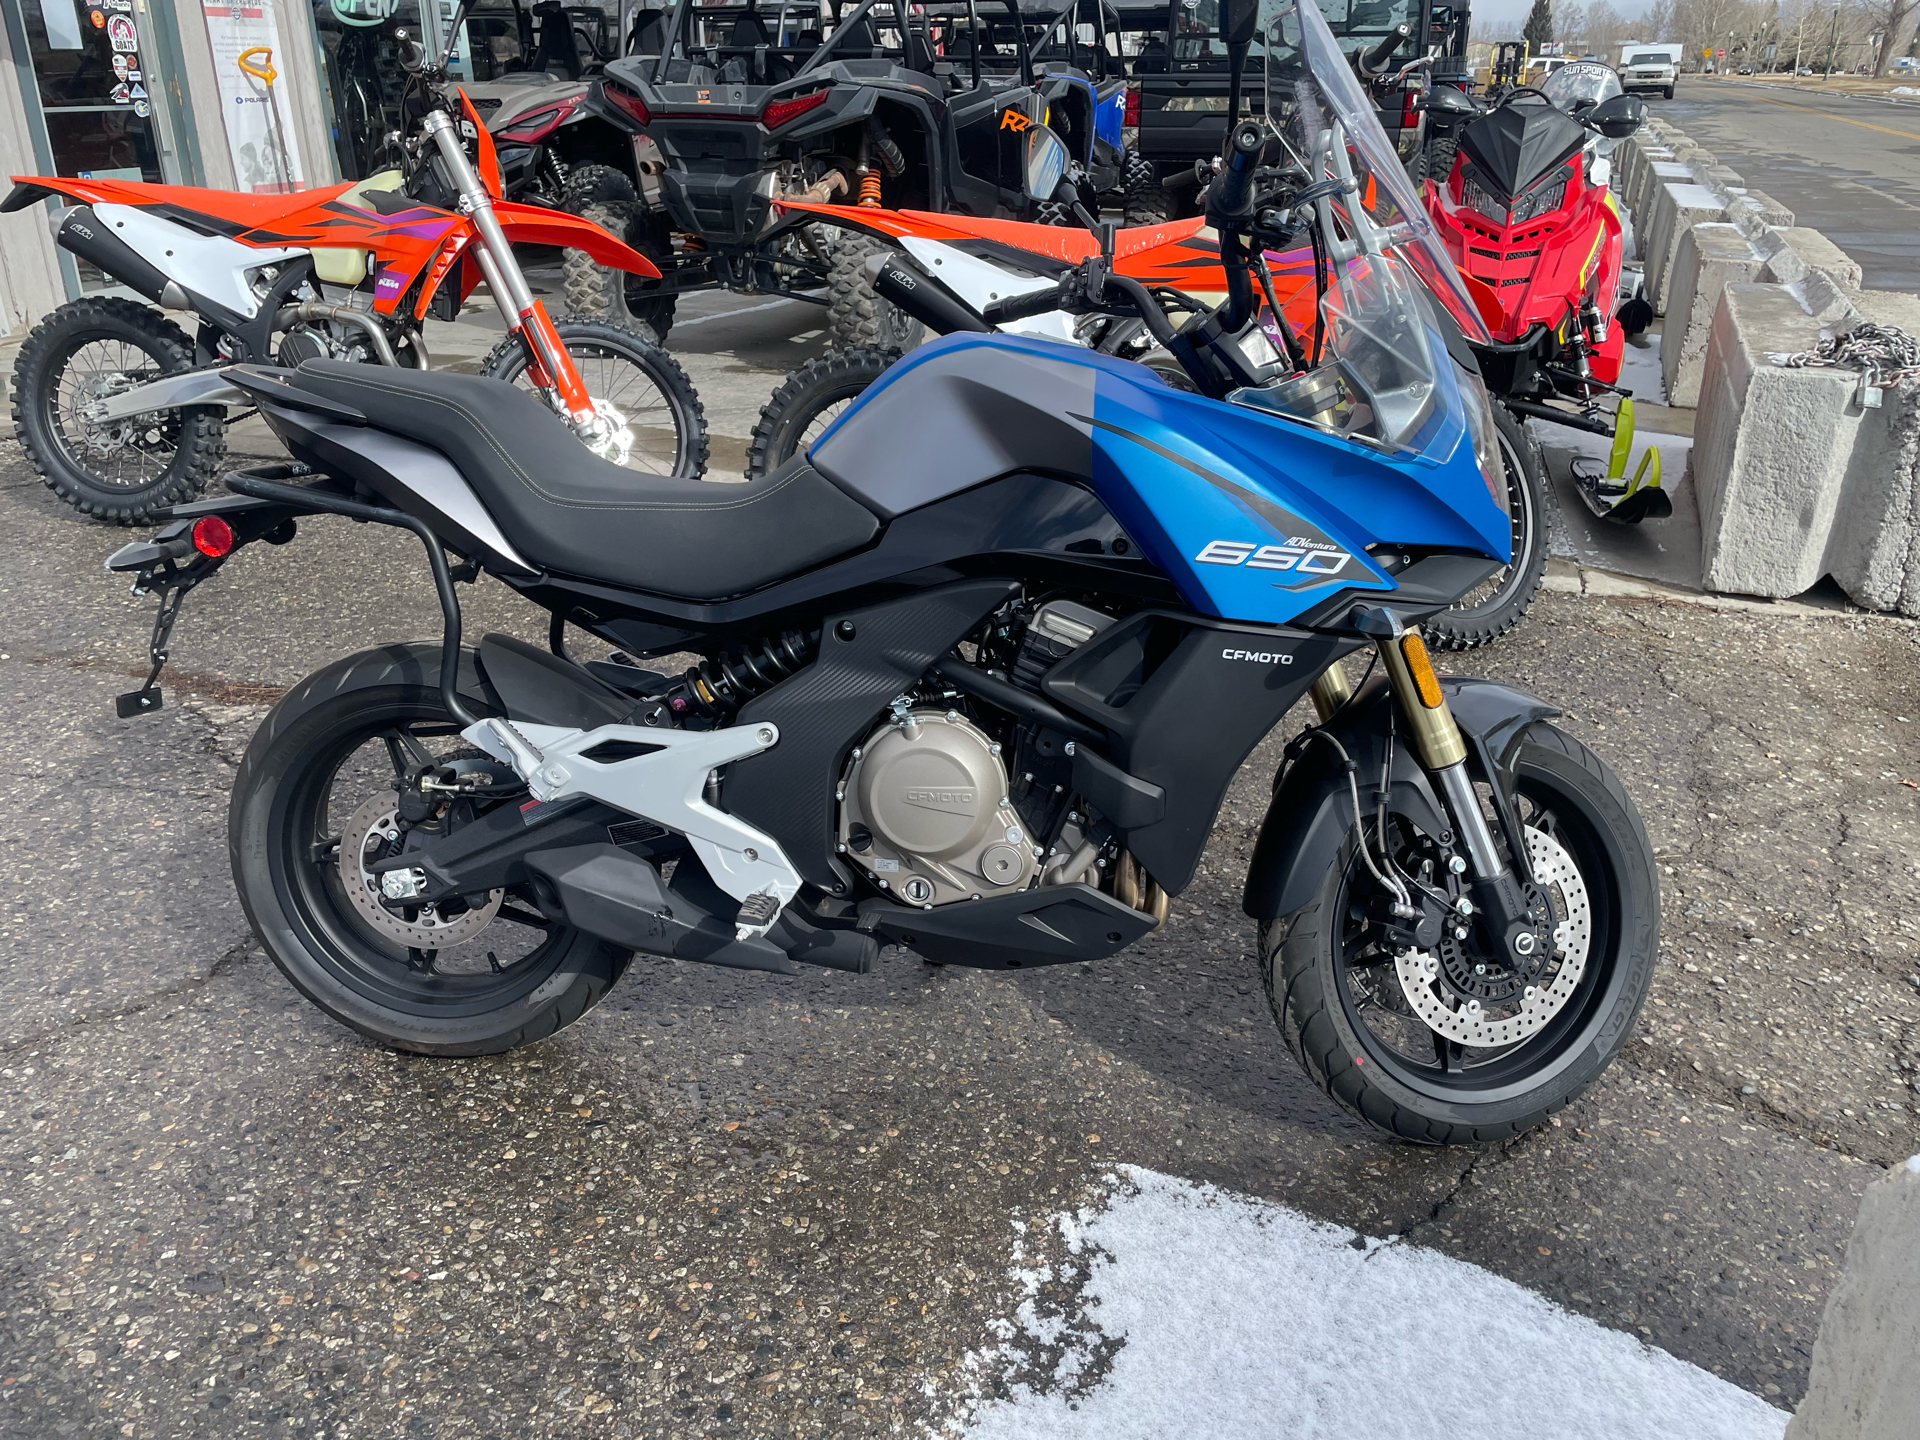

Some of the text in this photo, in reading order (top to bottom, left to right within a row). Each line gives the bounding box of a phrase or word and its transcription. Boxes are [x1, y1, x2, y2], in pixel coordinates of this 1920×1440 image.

[115, 40, 135, 50] GOATS
[1563, 65, 1612, 78] SUN SPORTS
[69, 223, 94, 240] KTM
[378, 277, 400, 289] KTM
[889, 270, 917, 290] KTM
[1284, 536, 1337, 551] ADVentura
[1195, 540, 1351, 575] 650
[1222, 648, 1294, 665] CFMOTO
[906, 789, 973, 803] CFMOTO
[1500, 880, 1525, 918] CFMOTO
